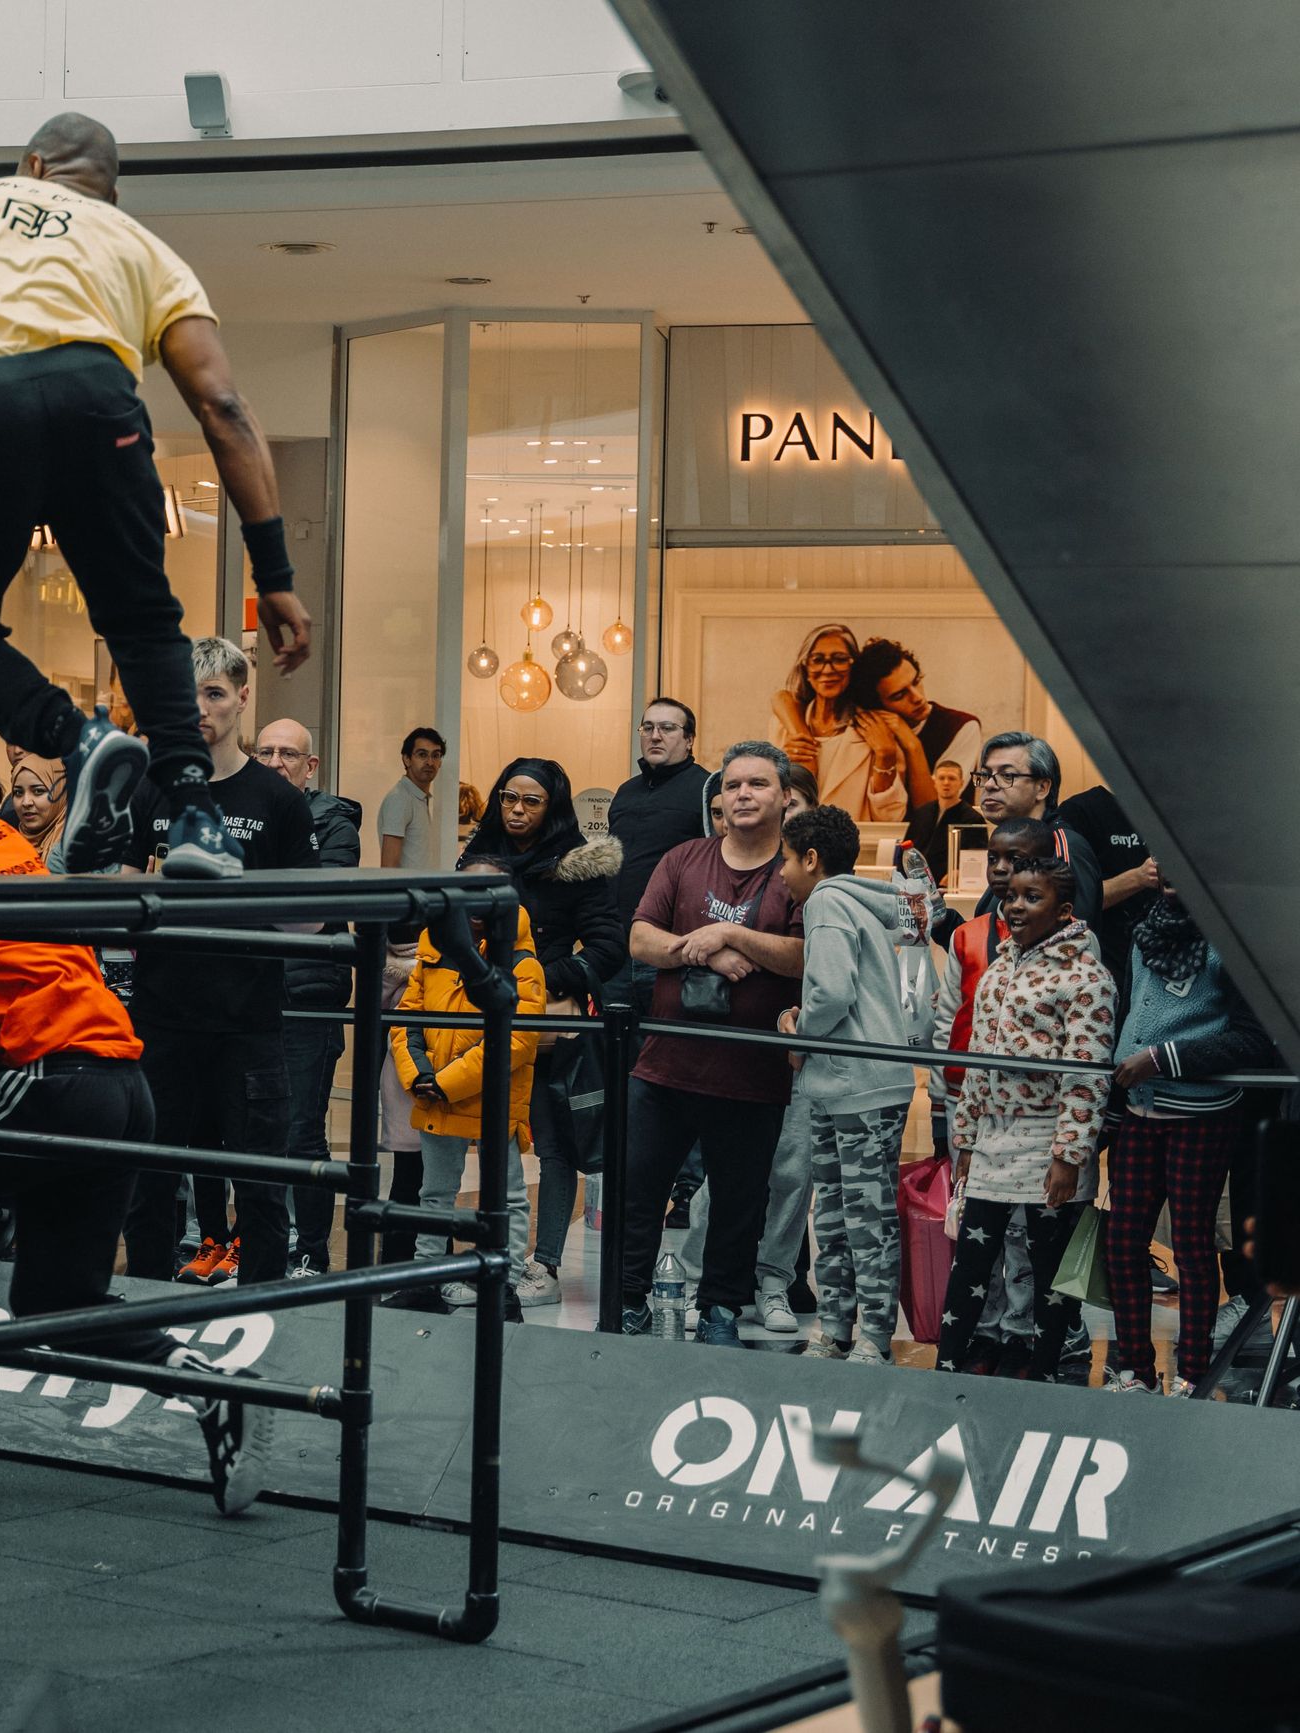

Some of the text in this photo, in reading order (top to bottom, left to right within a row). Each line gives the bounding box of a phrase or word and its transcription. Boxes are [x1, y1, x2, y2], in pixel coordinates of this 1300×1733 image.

[741, 412, 904, 461] PAN
[246, 819, 264, 831] TAG
[583, 822, 609, 830] -20%
[1110, 833, 1140, 848] evry2
[709, 898, 735, 921] RUN
[651, 1396, 1129, 1540] ON AIR
[624, 1490, 1092, 1563] ORIGINAL FTNES
